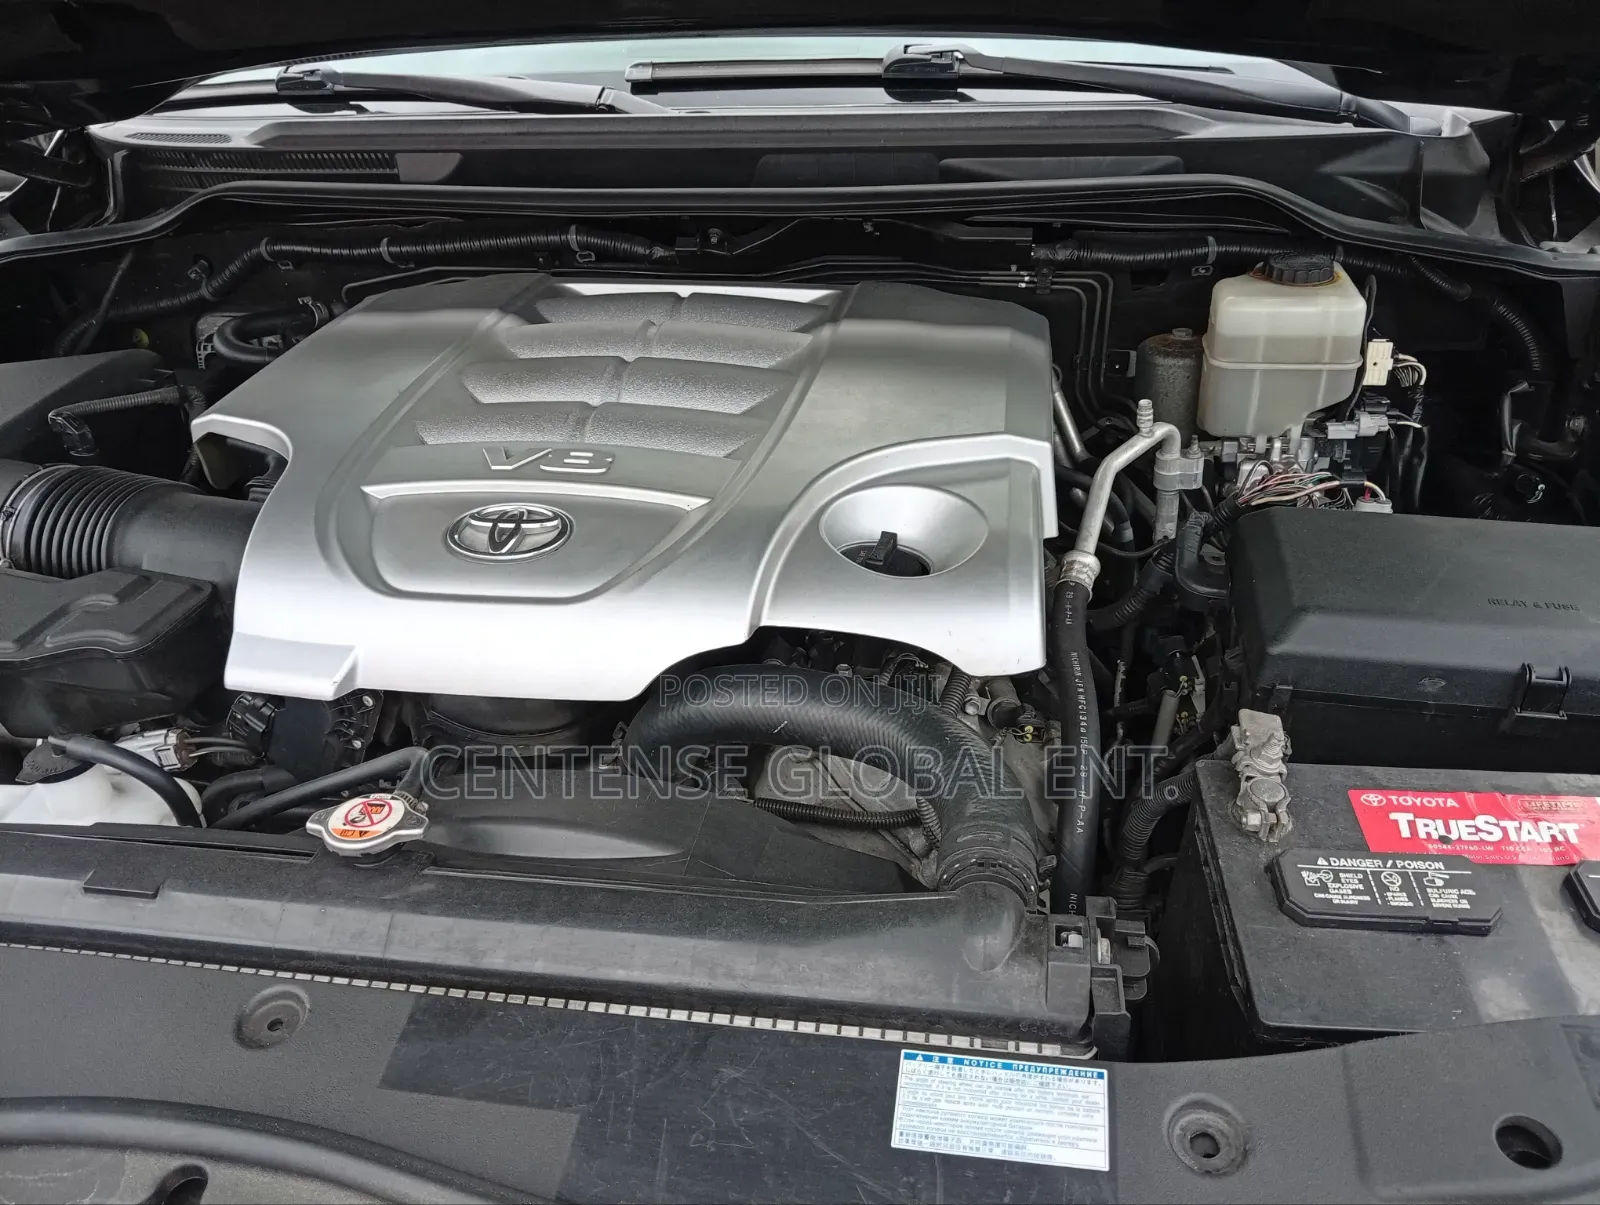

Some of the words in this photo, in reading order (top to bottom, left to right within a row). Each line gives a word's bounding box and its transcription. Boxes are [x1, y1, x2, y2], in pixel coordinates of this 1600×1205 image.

[482, 447, 616, 474] V8
[1487, 598, 1528, 608] RELAY
[1544, 602, 1581, 611] FUSE
[1388, 795, 1460, 808] TOYOTA
[1329, 857, 1383, 868] DANGER
[1395, 860, 1445, 871] POISON
[1327, 882, 1365, 890] EXPLOSIVE
[963, 1058, 1003, 1069] NOTICE
[1012, 1062, 1099, 1079] ПРЕДУПРЕЖДЕНИЕ
